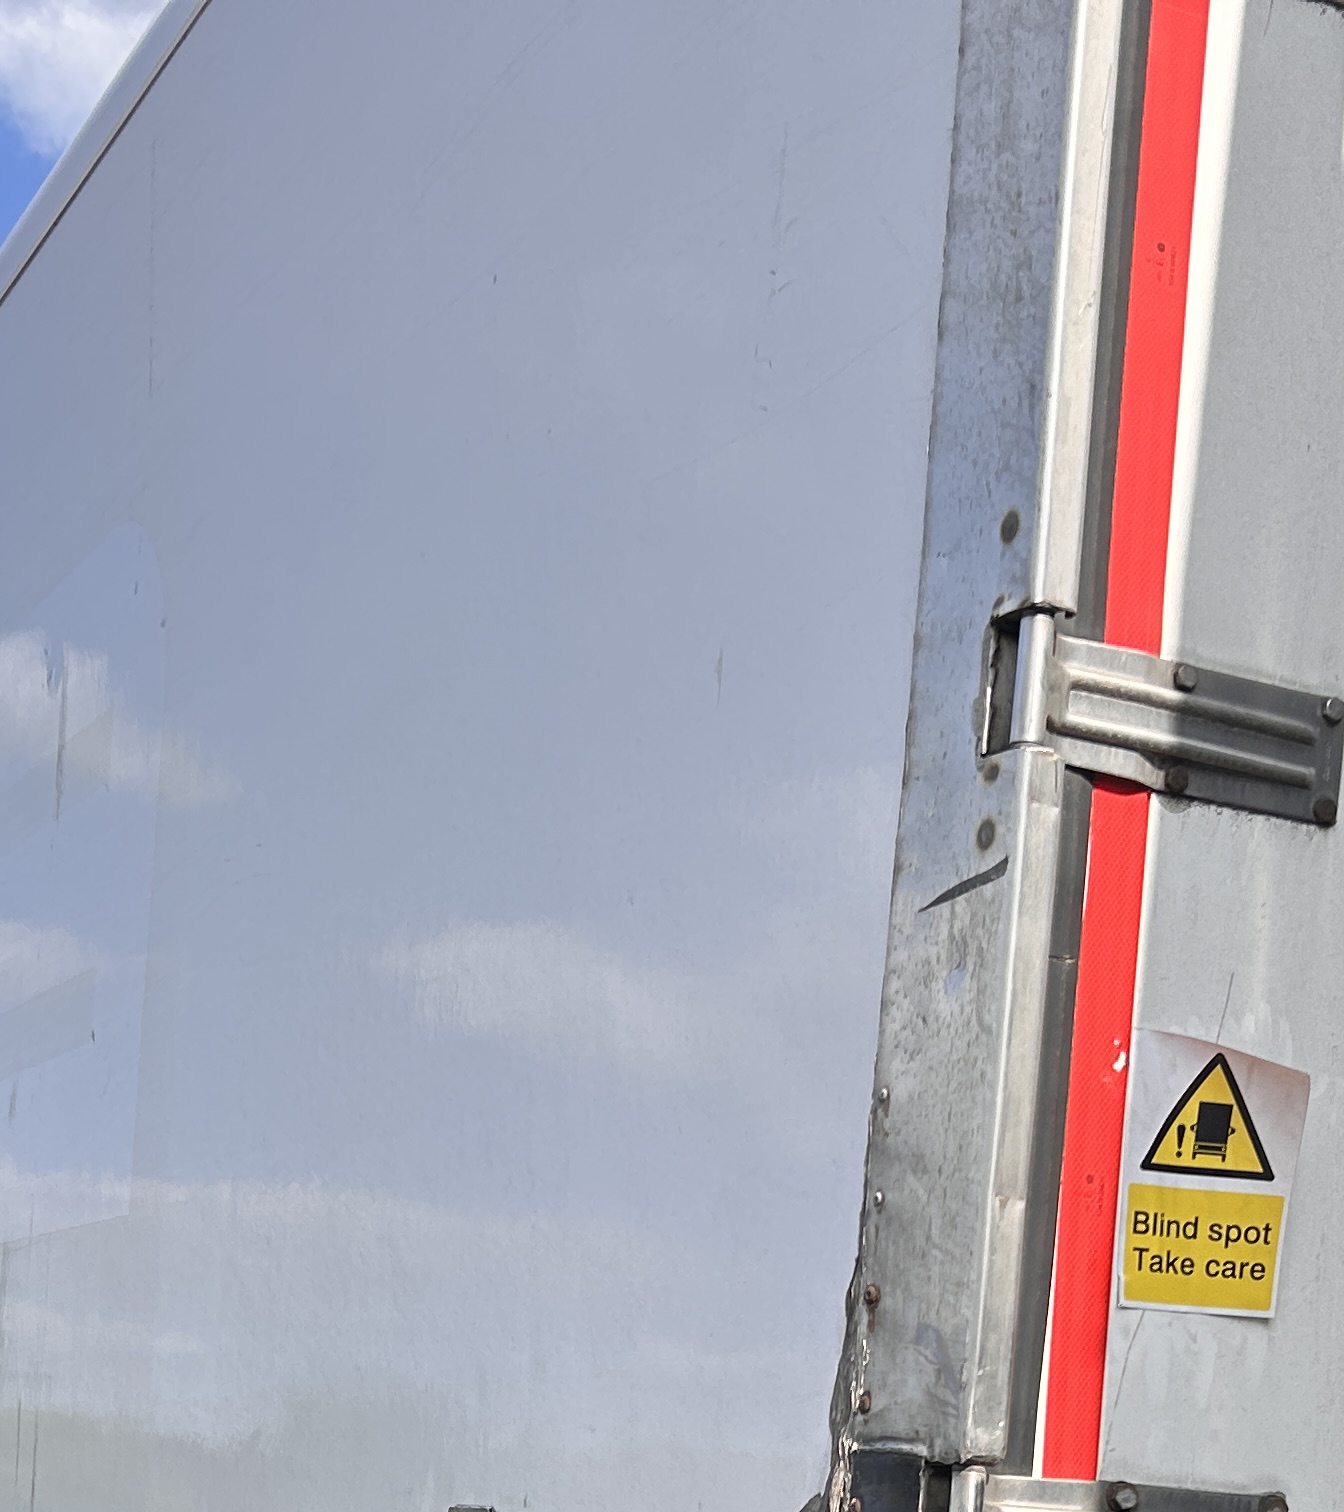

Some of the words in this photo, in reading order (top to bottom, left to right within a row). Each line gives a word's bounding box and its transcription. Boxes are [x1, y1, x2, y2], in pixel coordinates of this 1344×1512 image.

[1132, 1210, 1199, 1240] Blind
[1207, 1222, 1273, 1249] spot
[1132, 1246, 1195, 1276] Take
[1204, 1257, 1266, 1281] care
